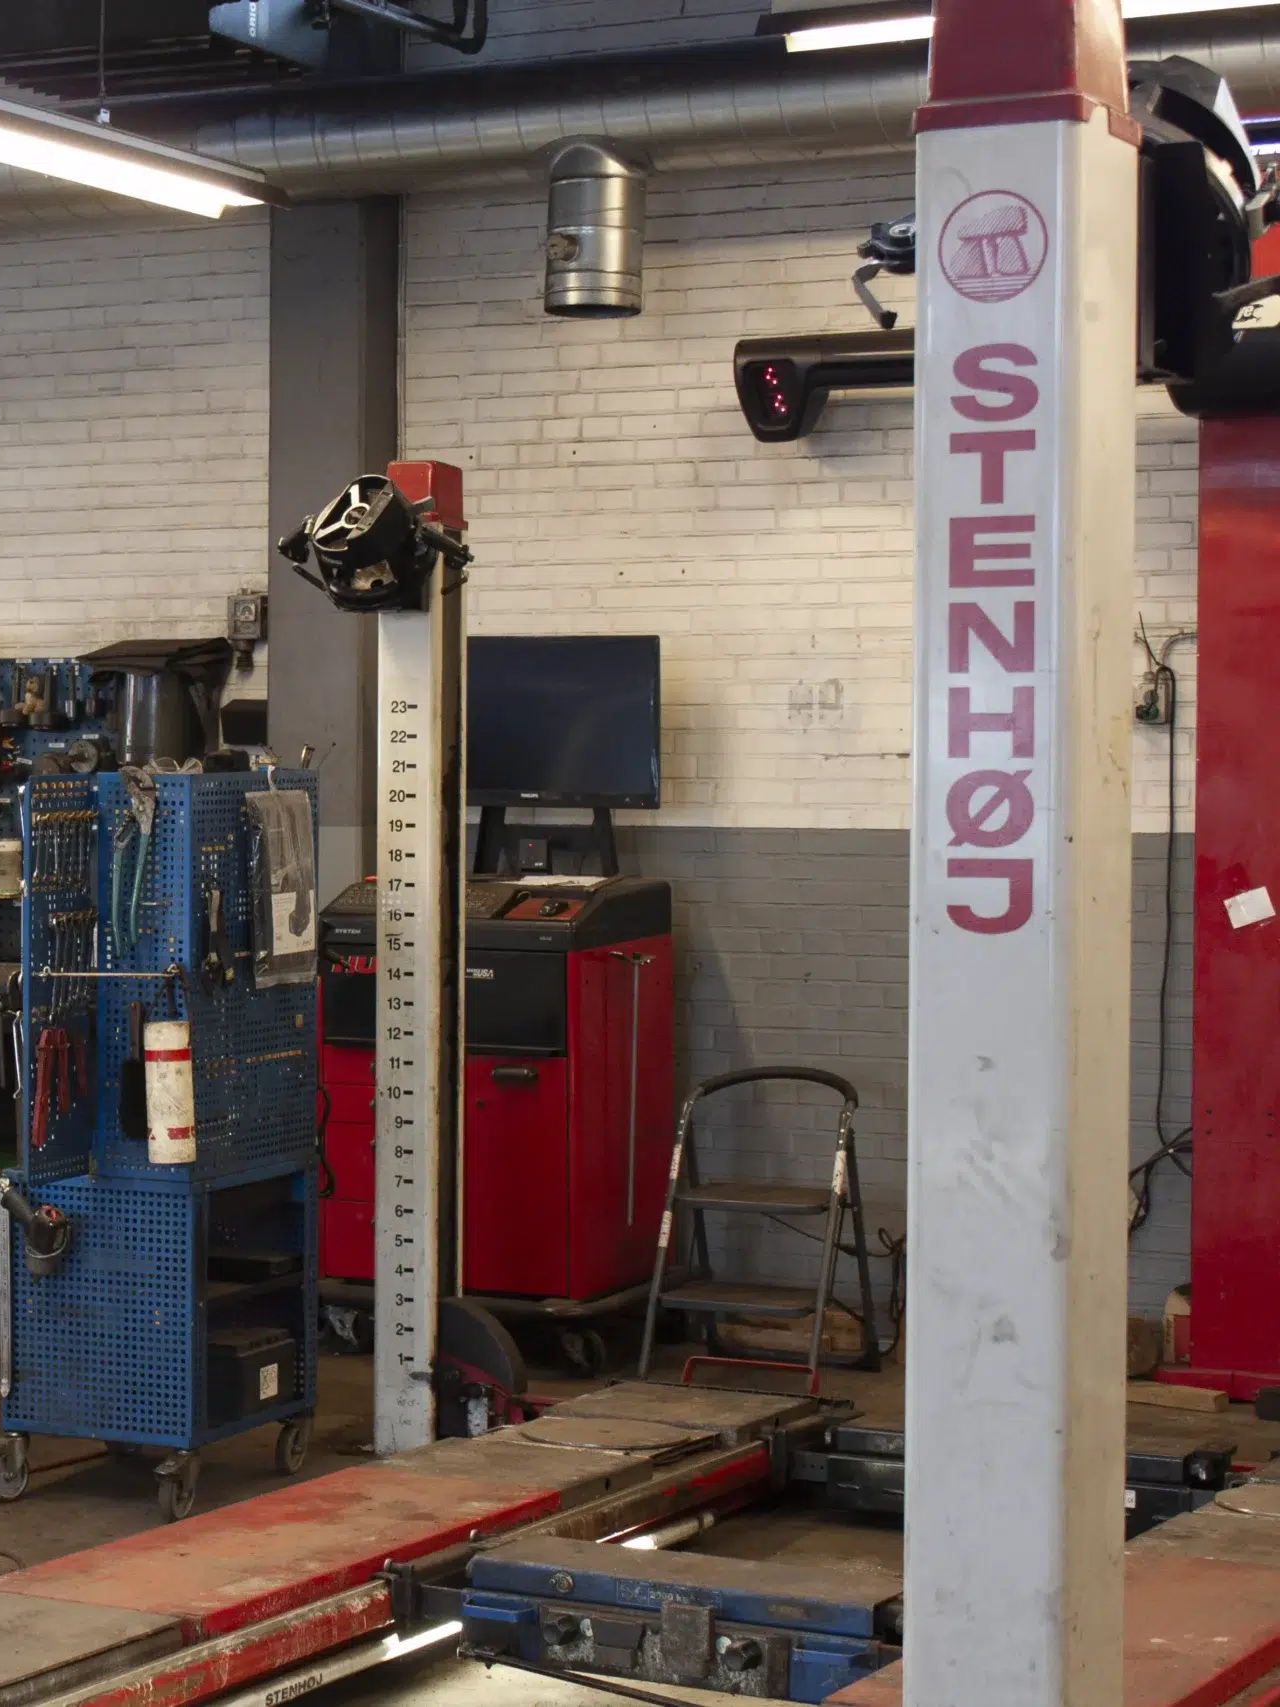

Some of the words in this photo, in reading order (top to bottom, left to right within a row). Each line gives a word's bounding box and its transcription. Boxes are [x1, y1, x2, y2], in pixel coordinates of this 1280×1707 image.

[945, 343, 1039, 934] STENHØJ
[391, 701, 407, 713] 23
[391, 730, 407, 743] 22
[393, 760, 405, 773] 21
[389, 790, 406, 802] 20
[388, 819, 403, 832] 19
[388, 849, 402, 862] 18
[388, 879, 402, 891] 17
[387, 909, 402, 921] 16
[387, 938, 401, 951] 15
[387, 968, 401, 980] 14
[387, 997, 401, 1010] 13
[387, 1027, 401, 1040] 12
[389, 1057, 400, 1069] 11
[387, 1086, 401, 1099] 10
[395, 1116, 403, 1128] 9
[395, 1146, 403, 1158] 8
[395, 1175, 403, 1187] 7
[395, 1205, 403, 1217] 6
[395, 1234, 403, 1247] 5
[395, 1264, 403, 1276] 4
[395, 1293, 403, 1306] 3
[395, 1323, 403, 1336] 2
